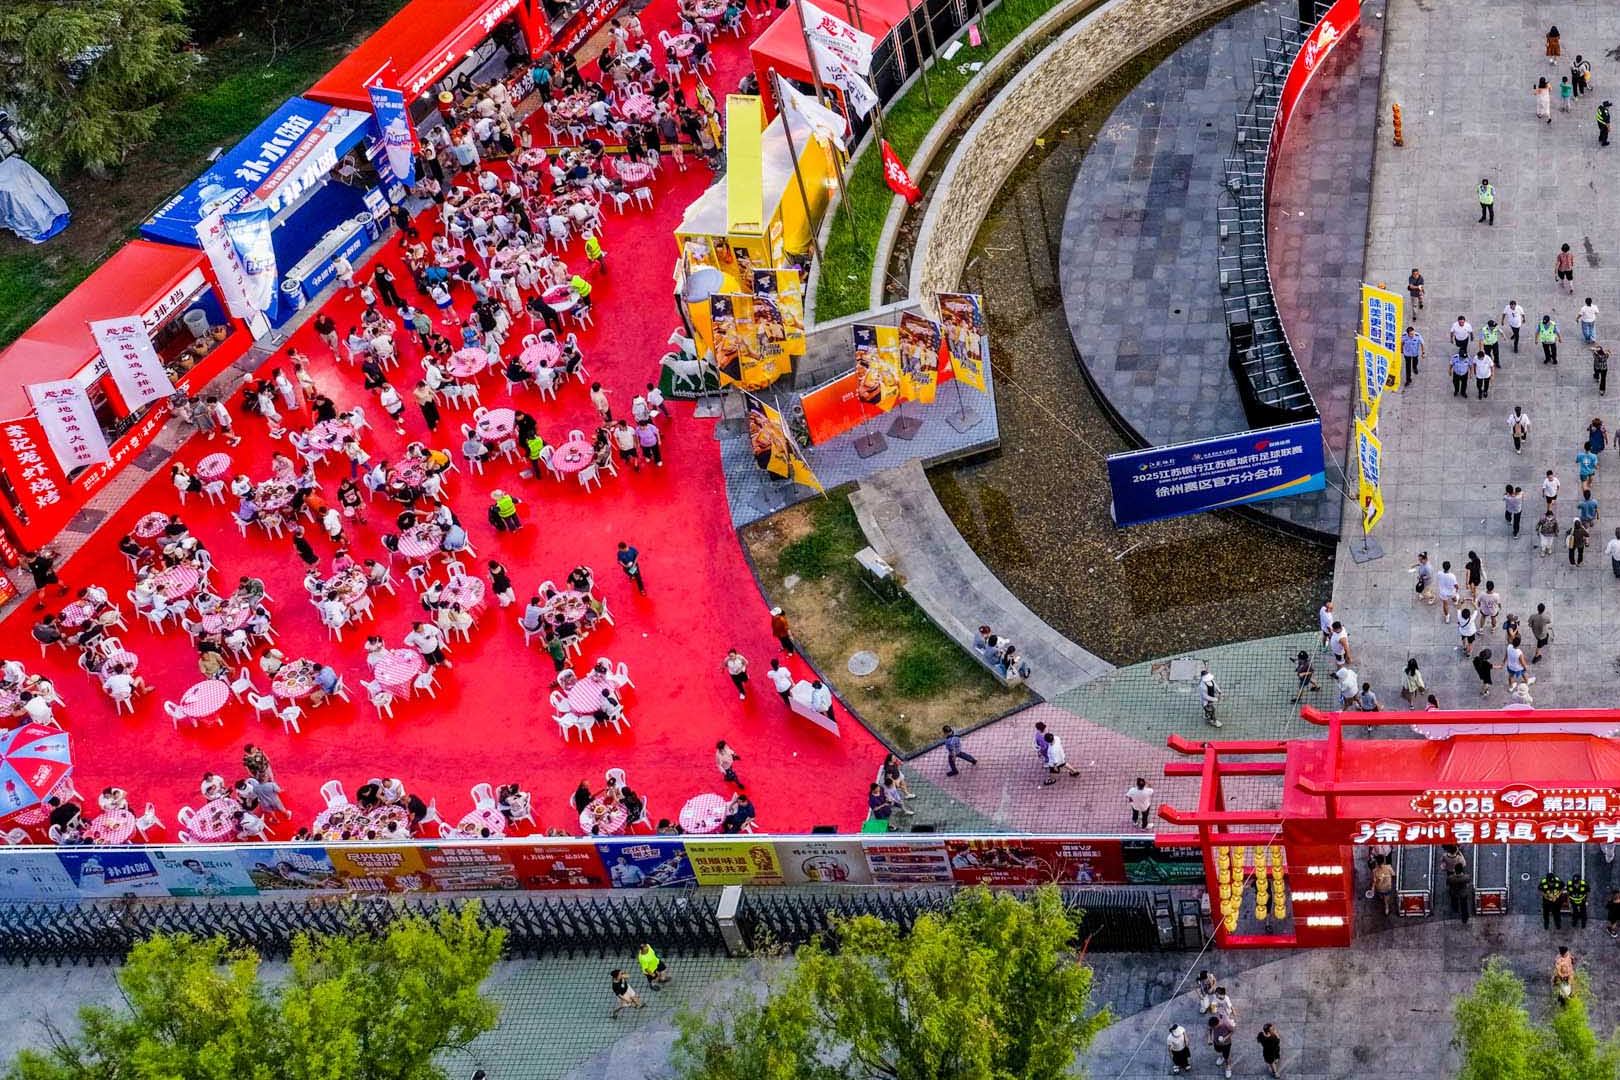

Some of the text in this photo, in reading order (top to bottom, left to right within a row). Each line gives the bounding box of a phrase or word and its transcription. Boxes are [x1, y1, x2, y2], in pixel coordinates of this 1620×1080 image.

[235, 114, 313, 183] 补水啦
[120, 344, 156, 397] 地锅鸡大排档
[57, 406, 91, 460] 地锅鸡大排档
[1132, 445, 1303, 484] 2025江苏银行江苏省城市足球联赛
[1155, 466, 1283, 498] 徐州赛区官方分会场
[1433, 796, 1495, 813] 2025
[1543, 795, 1608, 812] 第22届
[108, 863, 150, 878] 补水啦
